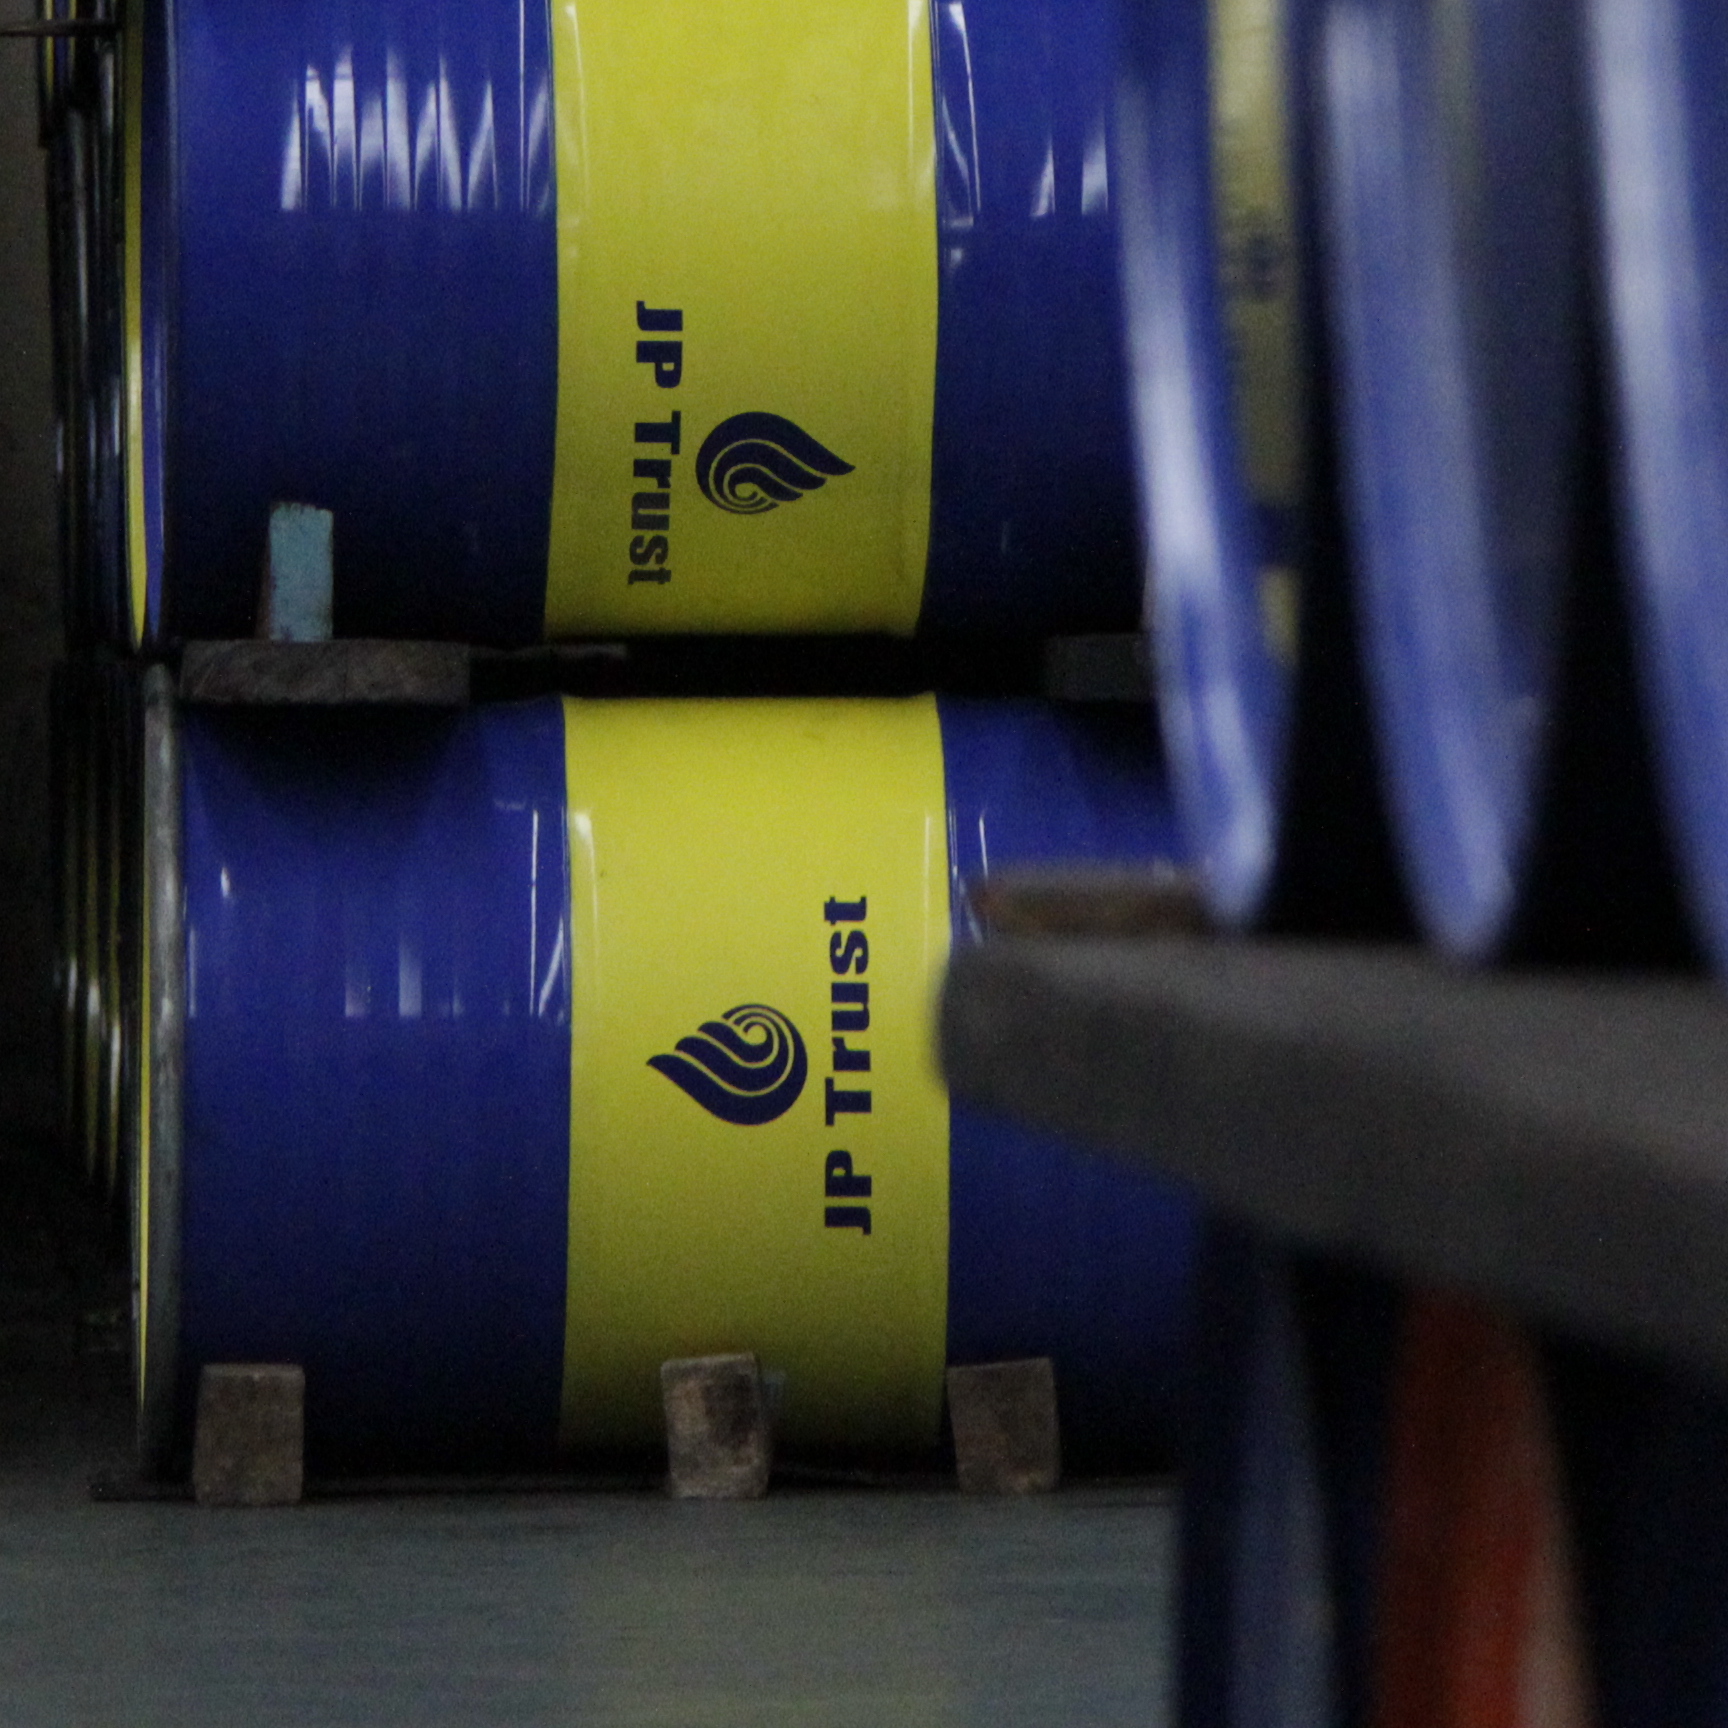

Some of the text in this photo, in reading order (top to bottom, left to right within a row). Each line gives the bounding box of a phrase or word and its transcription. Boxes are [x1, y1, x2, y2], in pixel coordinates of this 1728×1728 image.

[628, 300, 683, 585] JP Trust
[824, 896, 872, 1235] JP Trust
